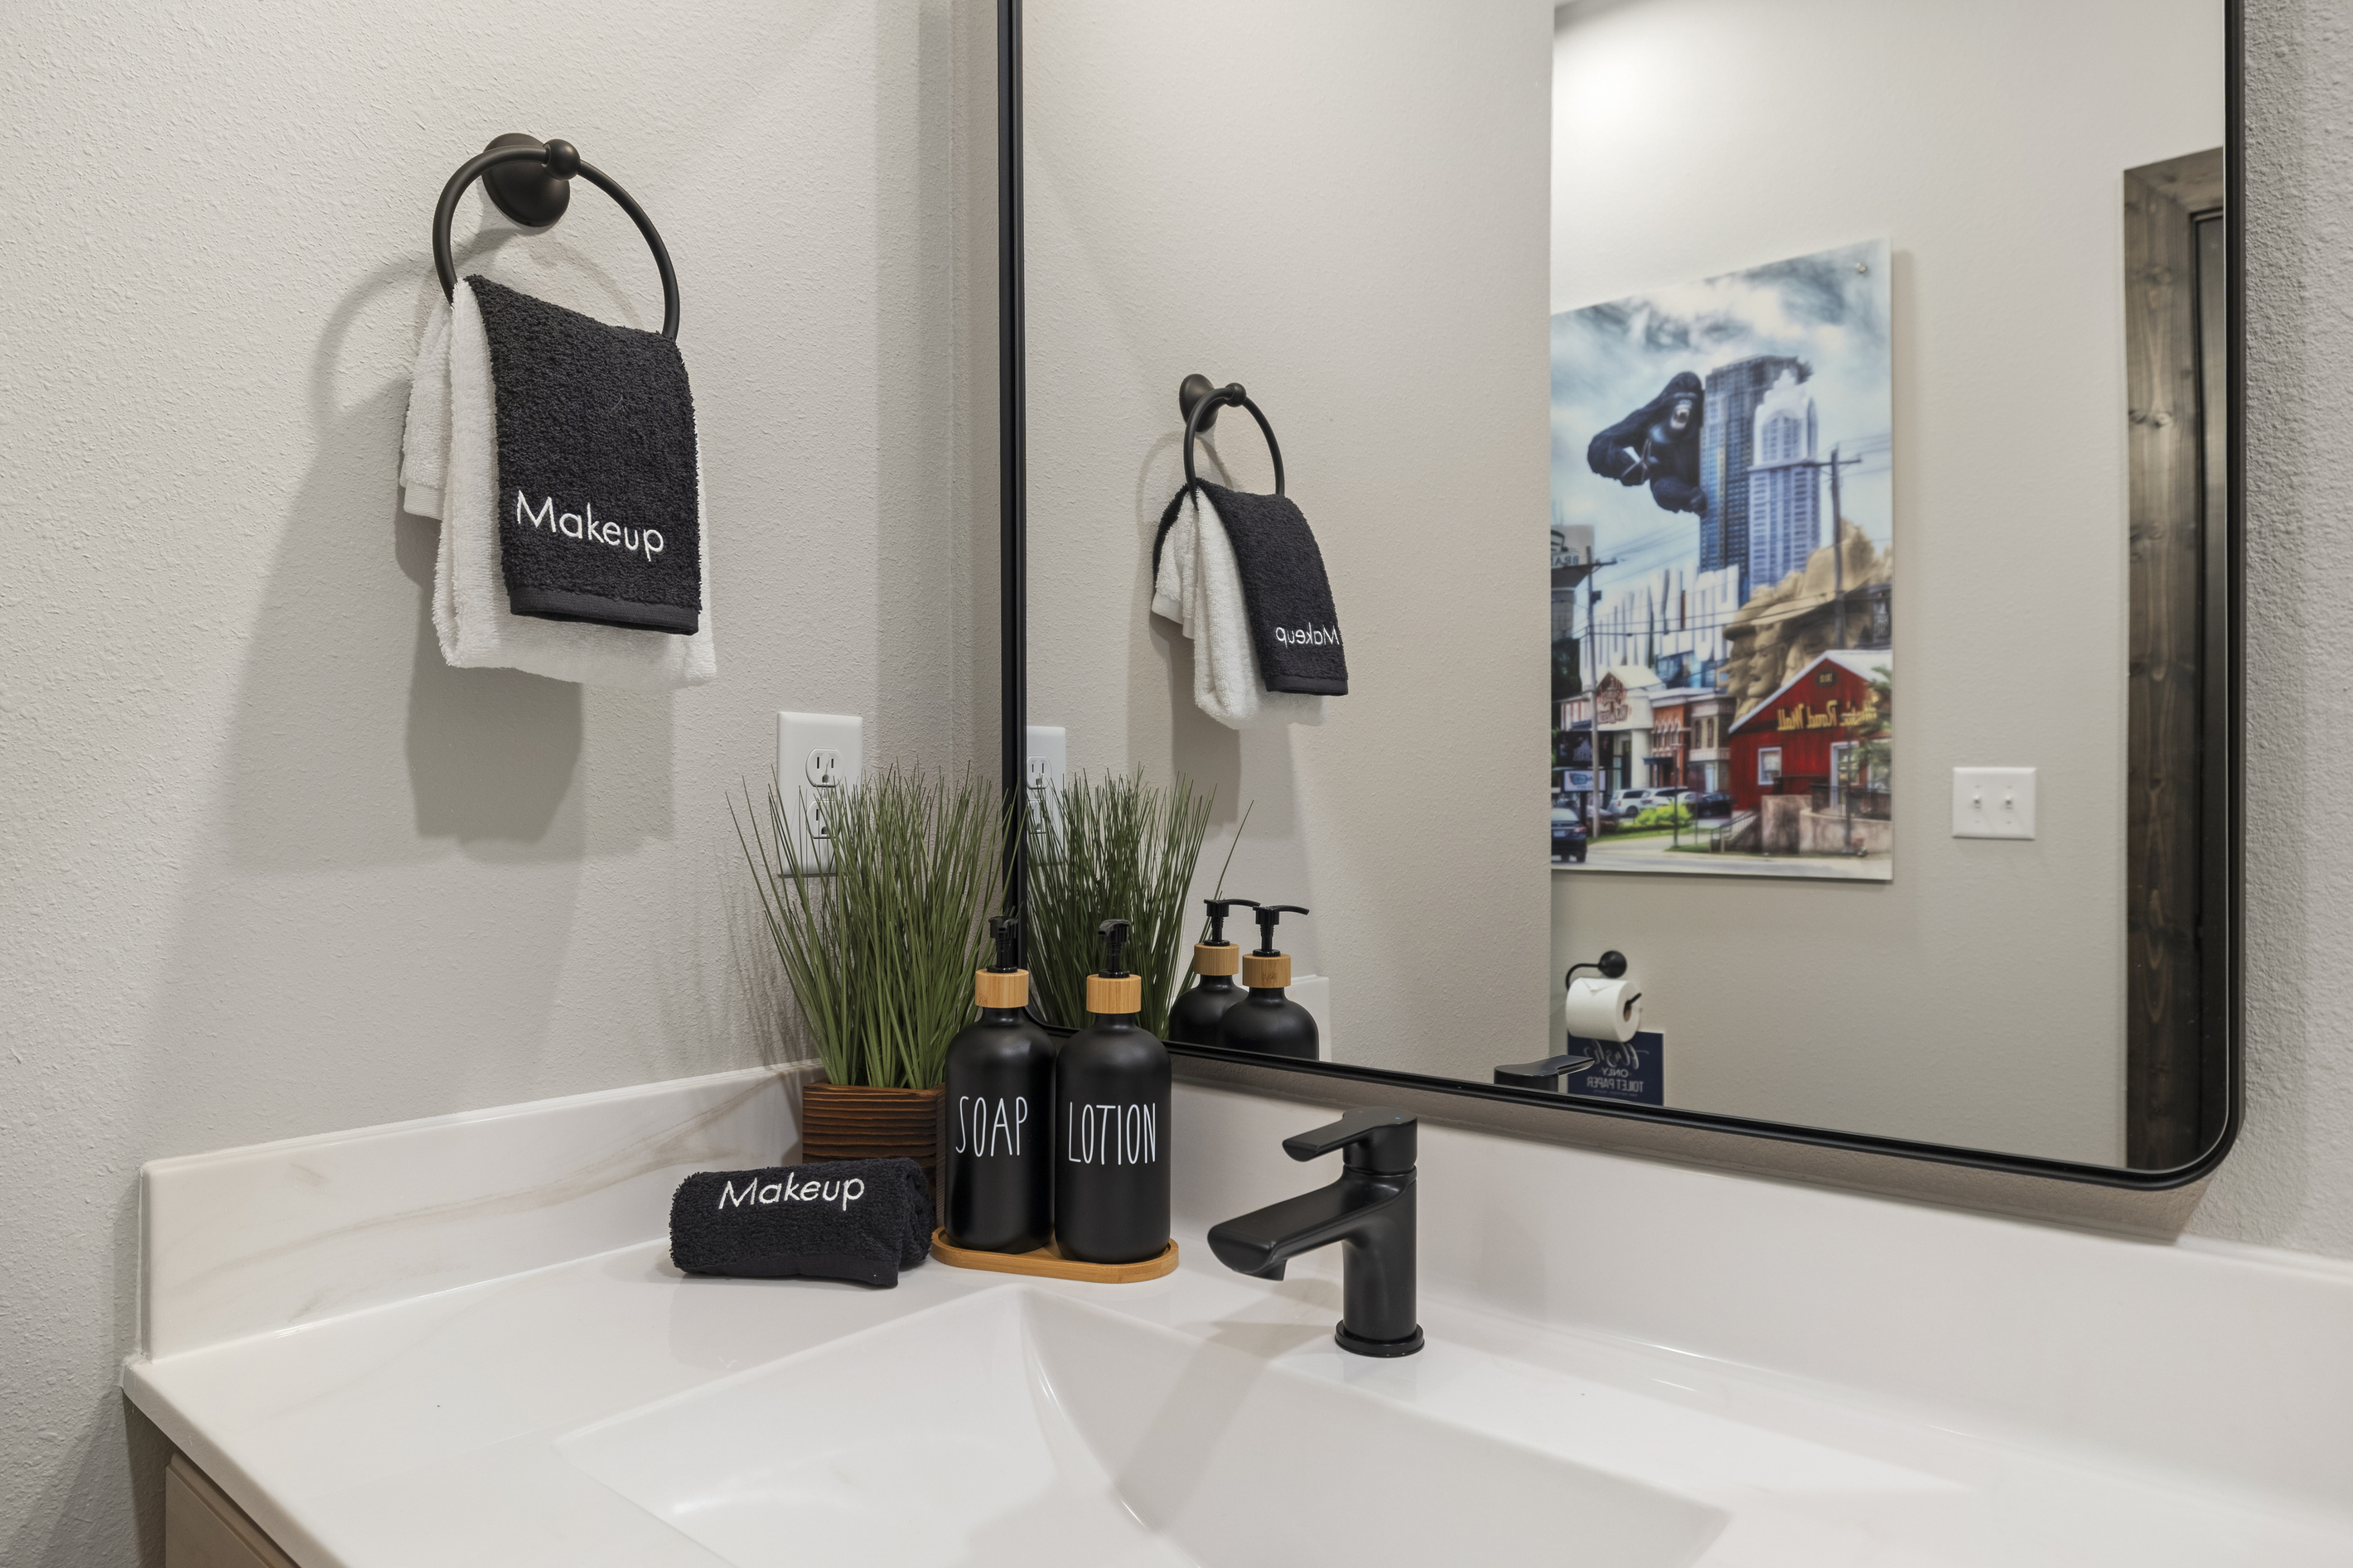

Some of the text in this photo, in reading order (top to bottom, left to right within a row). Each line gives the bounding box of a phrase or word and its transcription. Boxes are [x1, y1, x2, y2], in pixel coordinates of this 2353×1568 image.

[516, 490, 664, 562] Makeup
[955, 1096, 1027, 1157] SOAP
[1068, 1102, 1156, 1165] LOTION
[718, 1171, 865, 1211] Makeup
